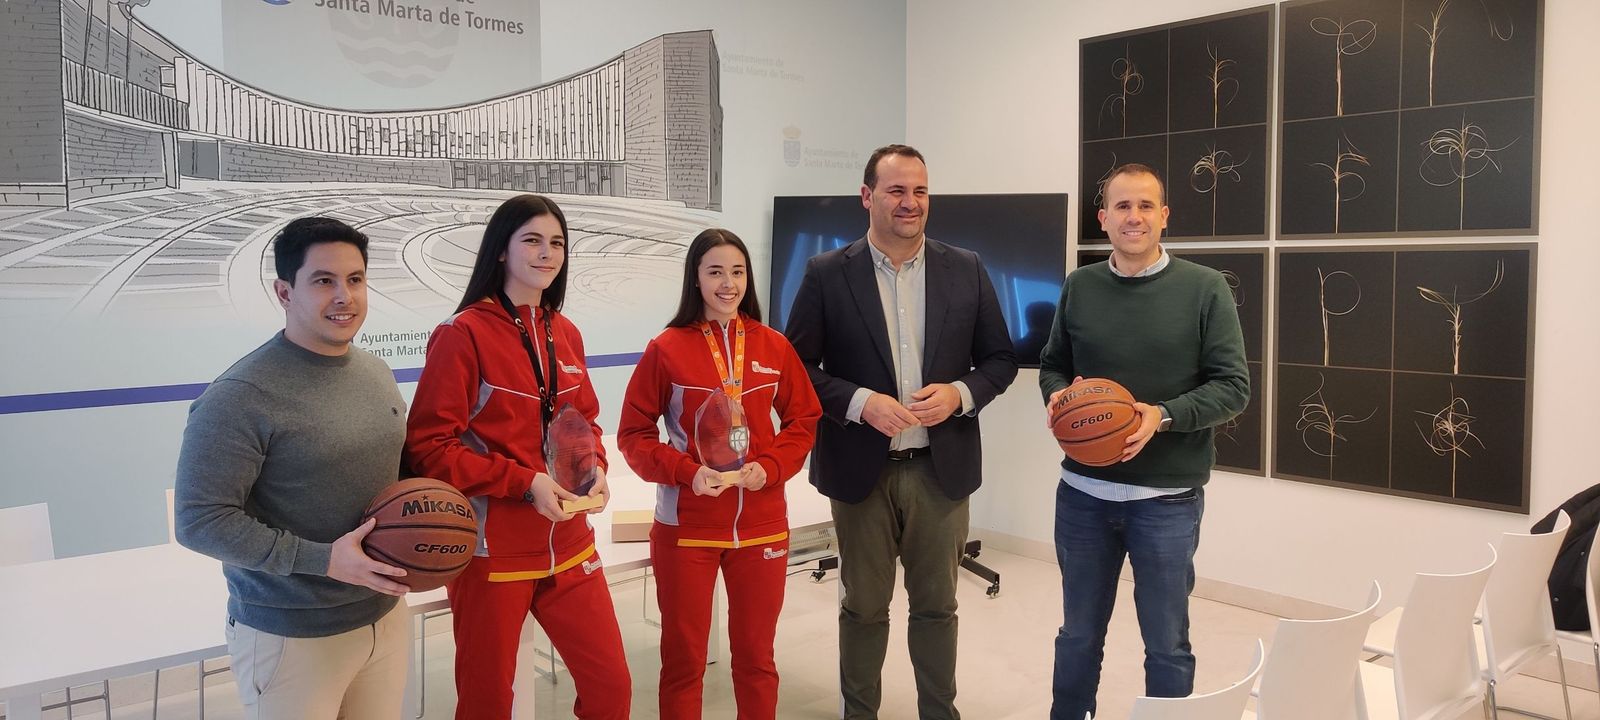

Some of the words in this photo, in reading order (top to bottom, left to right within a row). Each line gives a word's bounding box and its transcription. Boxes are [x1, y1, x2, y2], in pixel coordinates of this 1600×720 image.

[378, 0, 433, 22] Marta
[440, 7, 460, 26] de
[465, 11, 524, 34] Tormes
[360, 330, 431, 346] Ayuntamient
[1071, 411, 1113, 429] CF600
[414, 543, 468, 554] CF600
